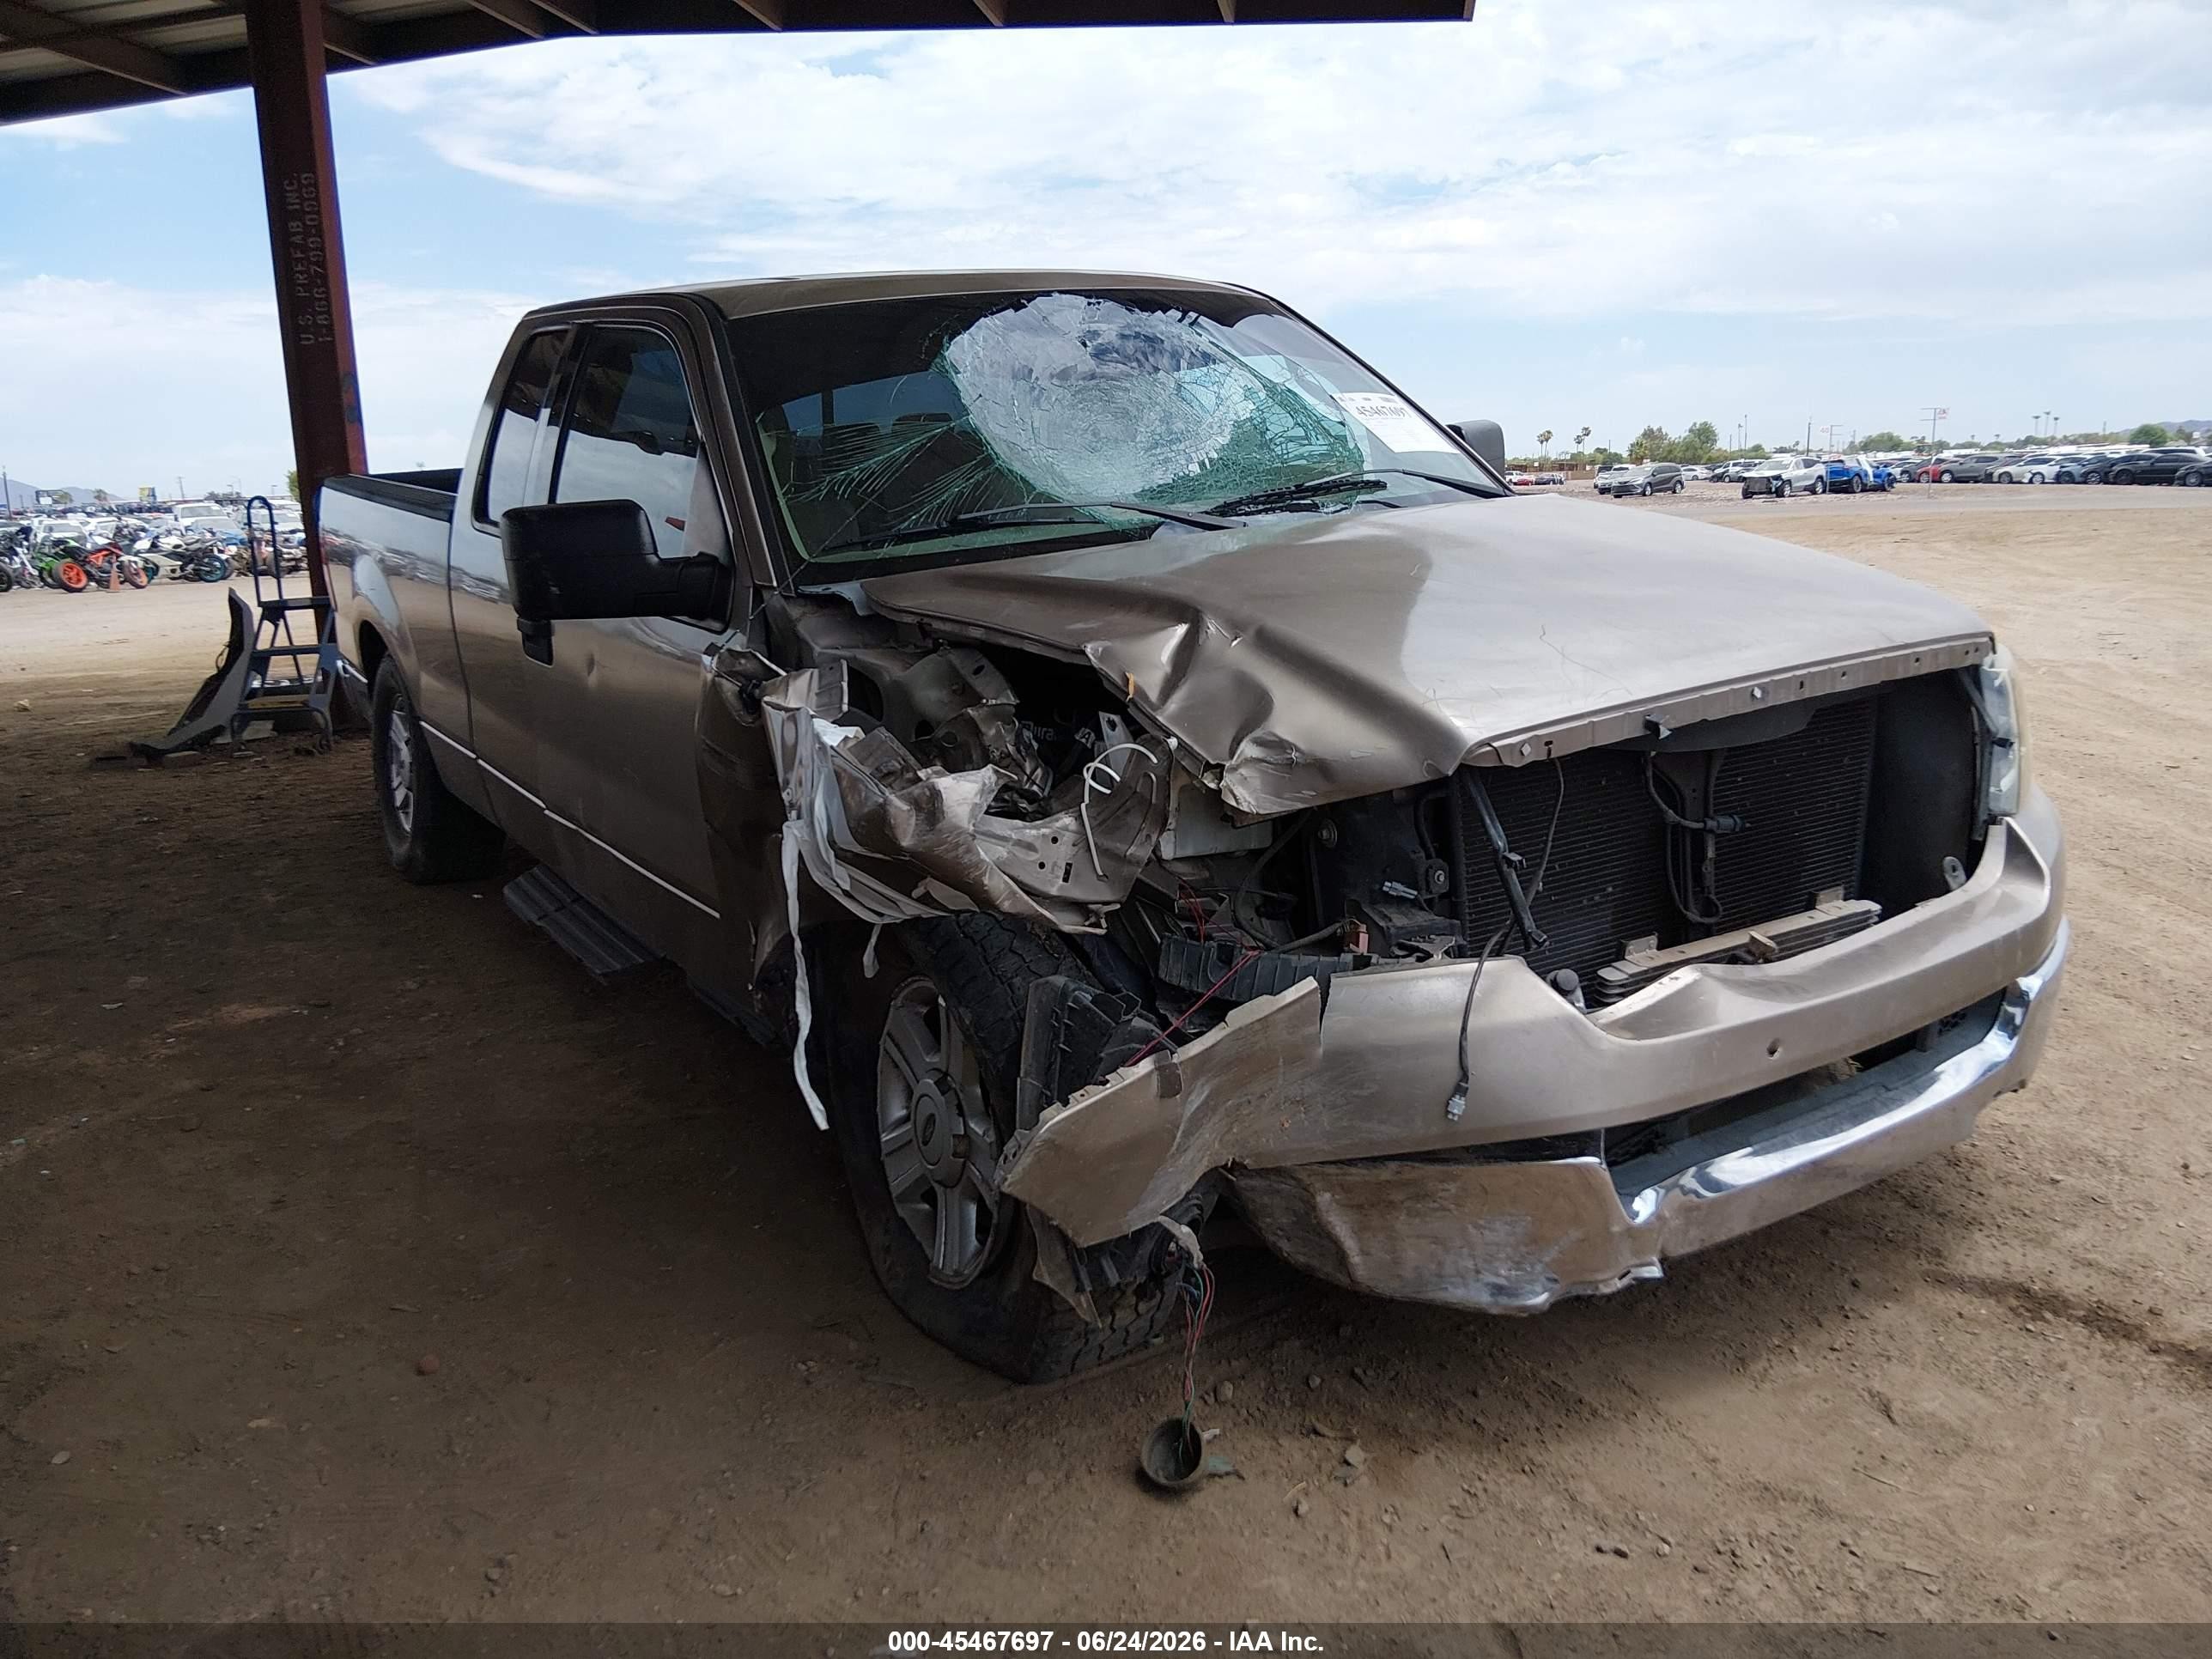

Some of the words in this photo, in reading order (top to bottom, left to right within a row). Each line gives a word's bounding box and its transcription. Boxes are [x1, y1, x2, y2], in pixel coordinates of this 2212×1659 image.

[283, 172, 301, 210] INC.
[288, 221, 310, 296] PREFAB
[297, 307, 316, 344] U.S.
